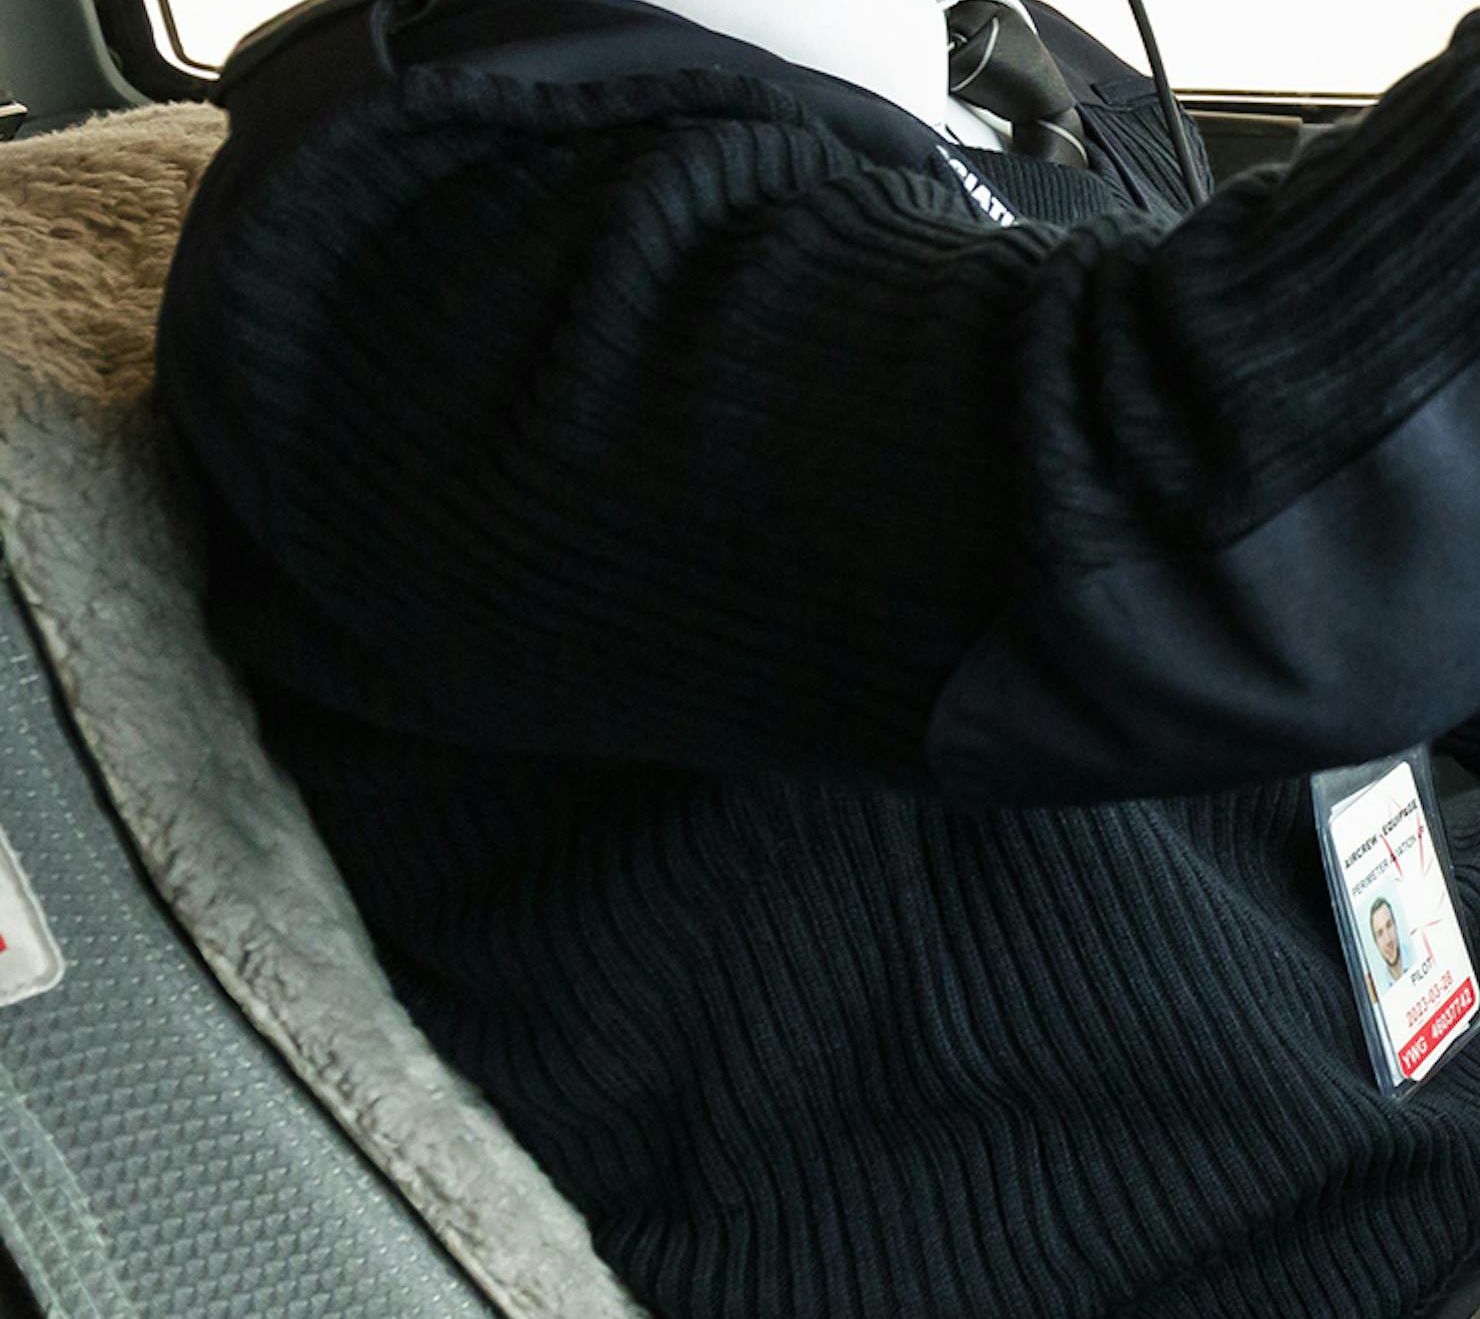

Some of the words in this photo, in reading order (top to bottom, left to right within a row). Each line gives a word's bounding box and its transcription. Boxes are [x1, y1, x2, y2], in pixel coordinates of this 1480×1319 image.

[1344, 834, 1378, 869] AIRCREW
[1410, 956, 1433, 985] PILOT
[1402, 1036, 1429, 1069] YWG
